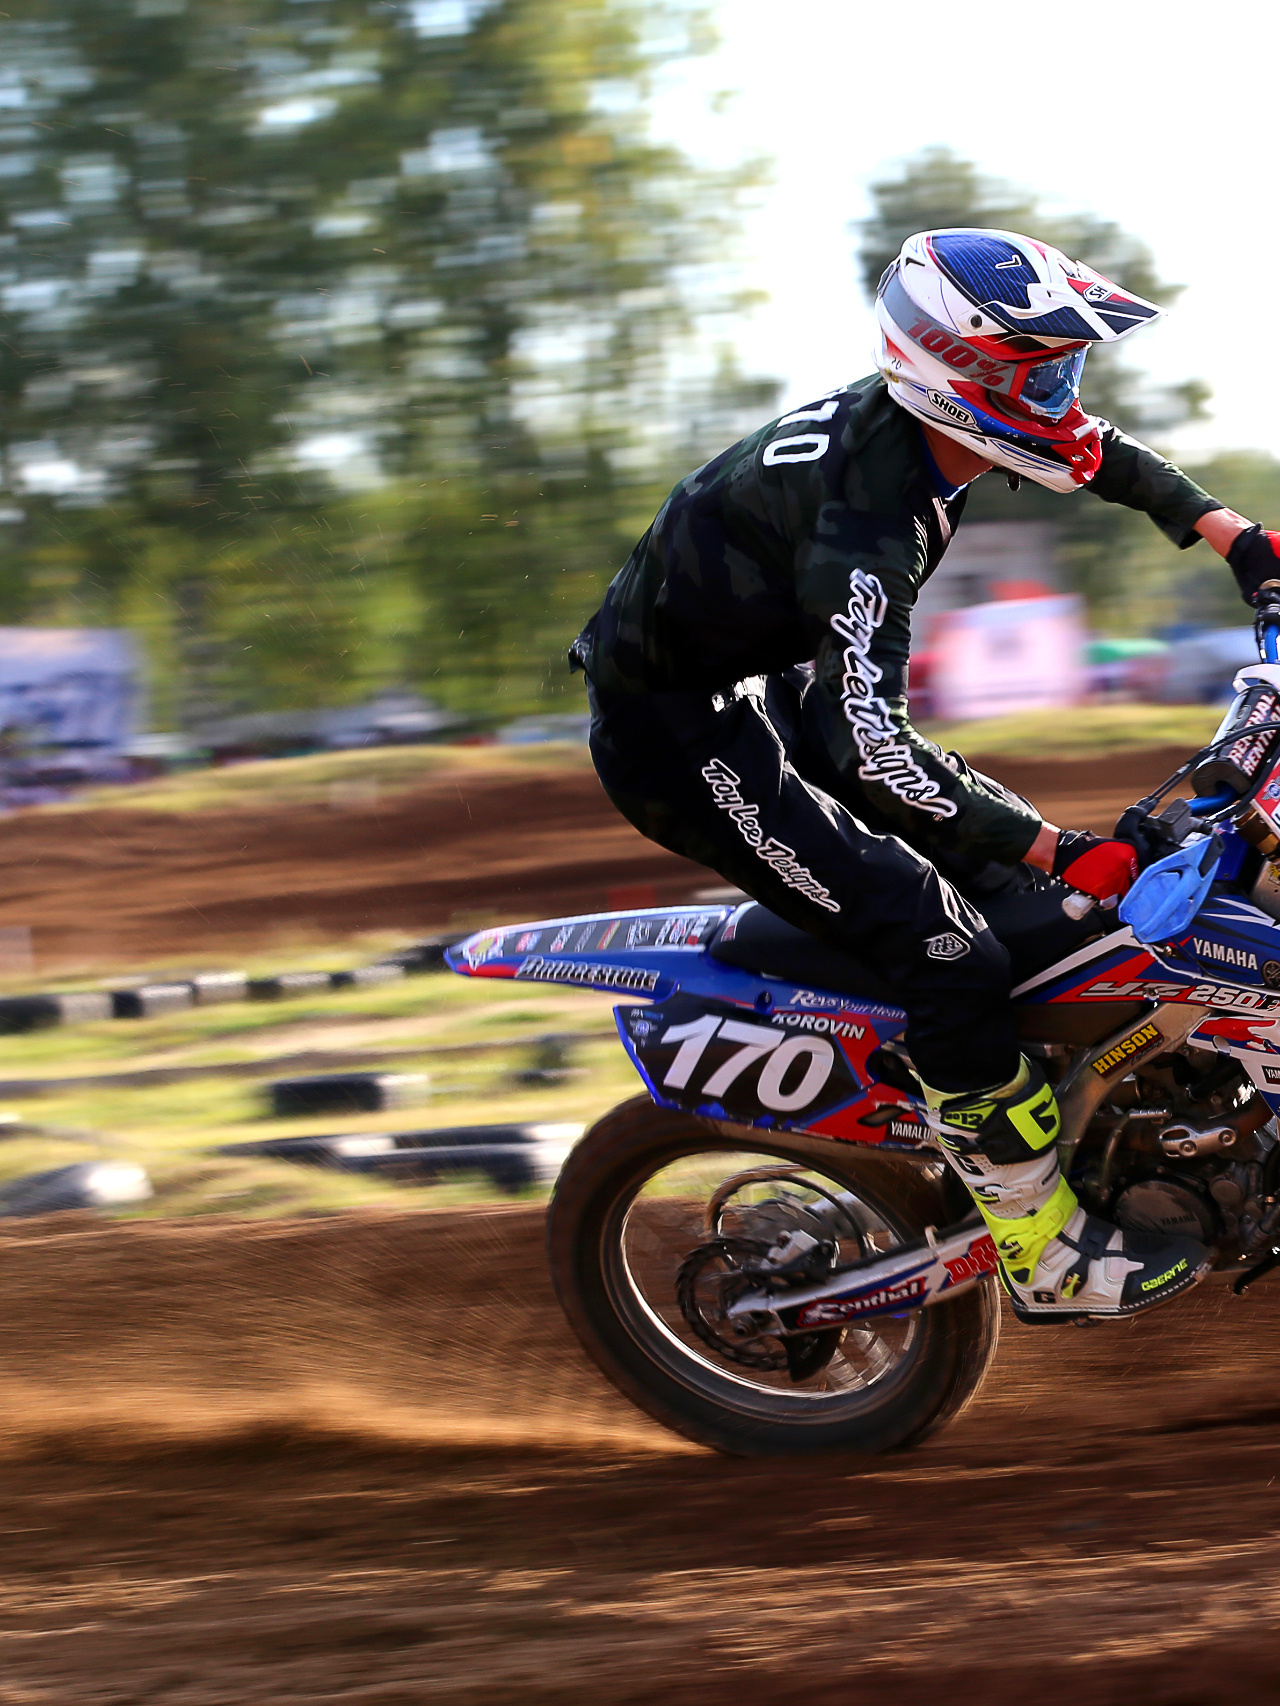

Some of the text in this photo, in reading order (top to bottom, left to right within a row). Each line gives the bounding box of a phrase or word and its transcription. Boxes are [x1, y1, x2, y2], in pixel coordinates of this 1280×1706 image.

[907, 316, 1010, 387] 100%
[931, 392, 971, 424] SHOEI
[701, 758, 842, 913] Troy Lee Designs
[1192, 937, 1258, 970] YAMAHA
[771, 1011, 866, 1040] KOROVIN
[660, 1013, 834, 1112] 170
[1092, 1024, 1159, 1074] HINSON
[891, 1121, 933, 1139] YAMALU
[1160, 1214, 1198, 1227] YAMAHA
